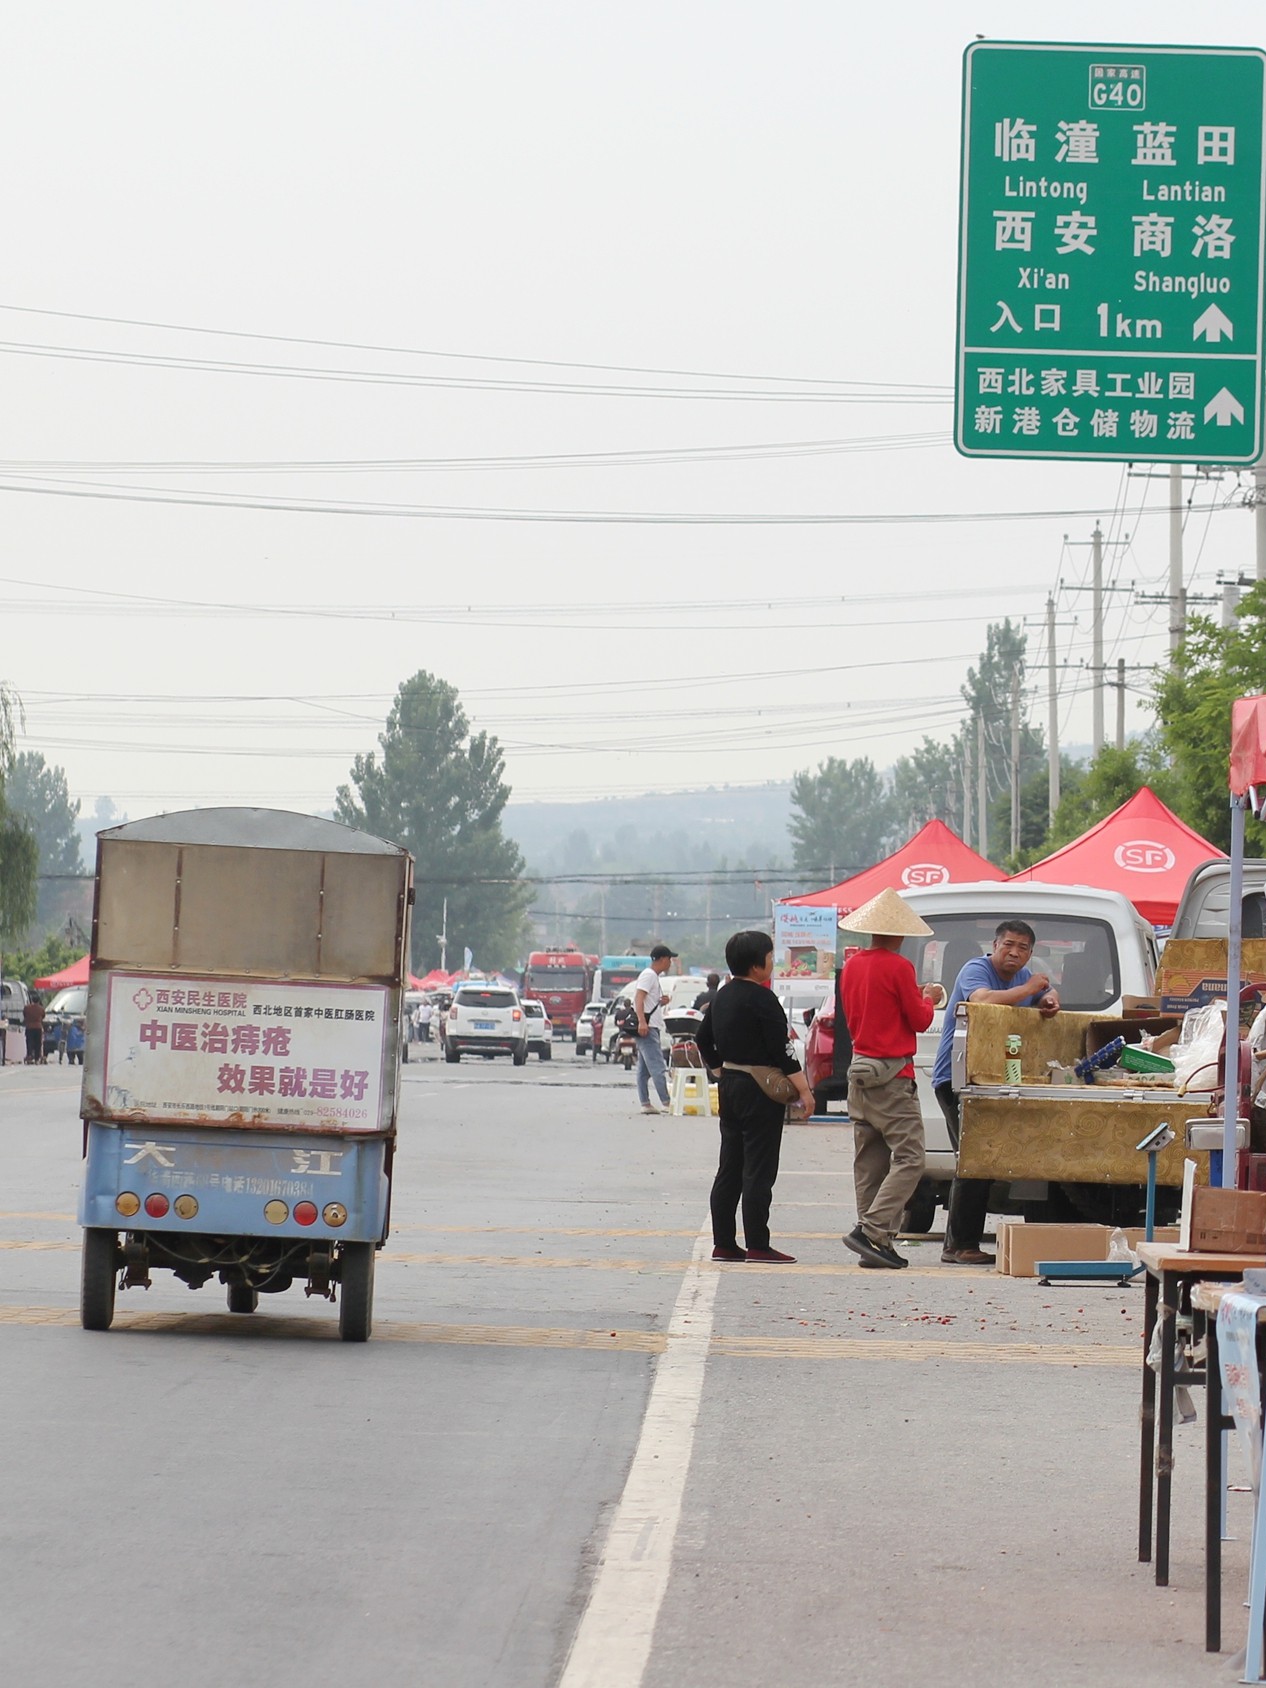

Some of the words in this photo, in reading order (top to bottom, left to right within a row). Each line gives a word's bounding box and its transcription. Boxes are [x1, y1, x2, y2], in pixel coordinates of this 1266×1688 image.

[1093, 82, 1142, 106] G40
[994, 118, 1100, 164] 临潼
[1131, 122, 1236, 166] 蓝田
[1004, 176, 1088, 205] Lintong
[1142, 180, 1226, 202] Lantian
[993, 210, 1098, 255] 西安
[1131, 213, 1236, 259] 商洛
[1018, 267, 1070, 290] Xi'an
[1133, 270, 1231, 299] Shangluo
[990, 300, 1061, 333] 入口
[1097, 303, 1162, 339] 1km
[977, 367, 1196, 400] 西北家具工业园
[974, 405, 1196, 440] 新港仓储物流
[1125, 848, 1162, 865] SF
[911, 871, 940, 884] SF
[156, 989, 248, 1009] 西安民生医院
[156, 1006, 174, 1014] XIAN
[174, 1007, 212, 1016] MINSHENG
[213, 1008, 247, 1017] HOSPITAL
[252, 1004, 376, 1022] 西北地区首家中医肛肠医院
[139, 1019, 292, 1057] 中医治痔疮
[216, 1063, 369, 1101] 效果就是好
